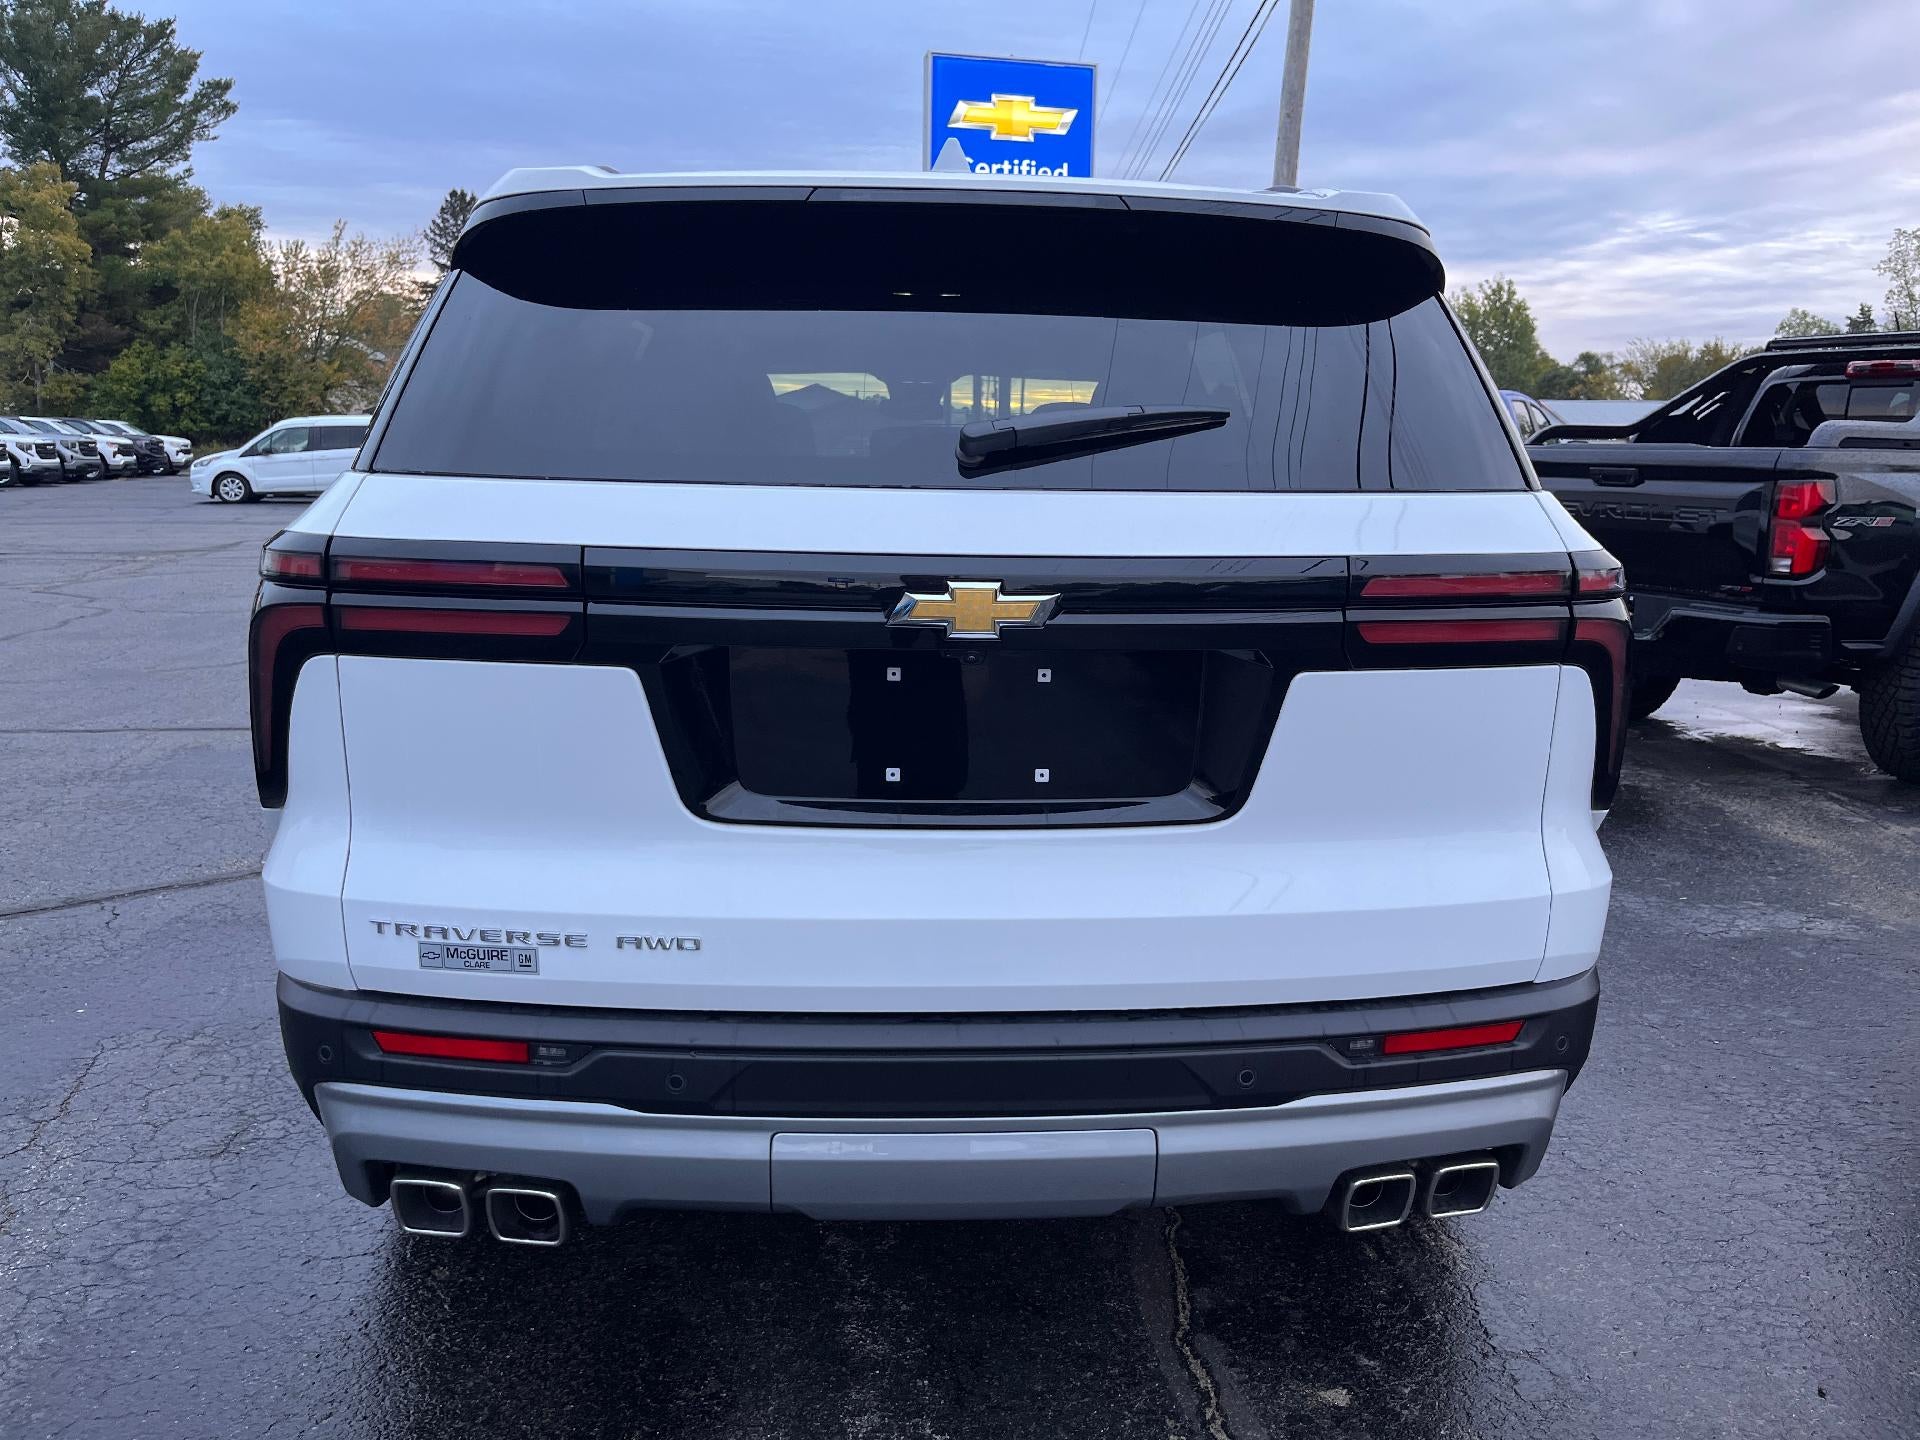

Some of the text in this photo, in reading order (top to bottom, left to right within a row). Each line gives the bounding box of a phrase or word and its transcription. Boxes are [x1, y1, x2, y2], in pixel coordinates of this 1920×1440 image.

[965, 157, 1068, 177] ertified
[369, 919, 701, 950] TRAVERSE AWD
[446, 947, 510, 961] McGUIRE
[518, 953, 532, 964] GM
[463, 960, 491, 969] CLARE
